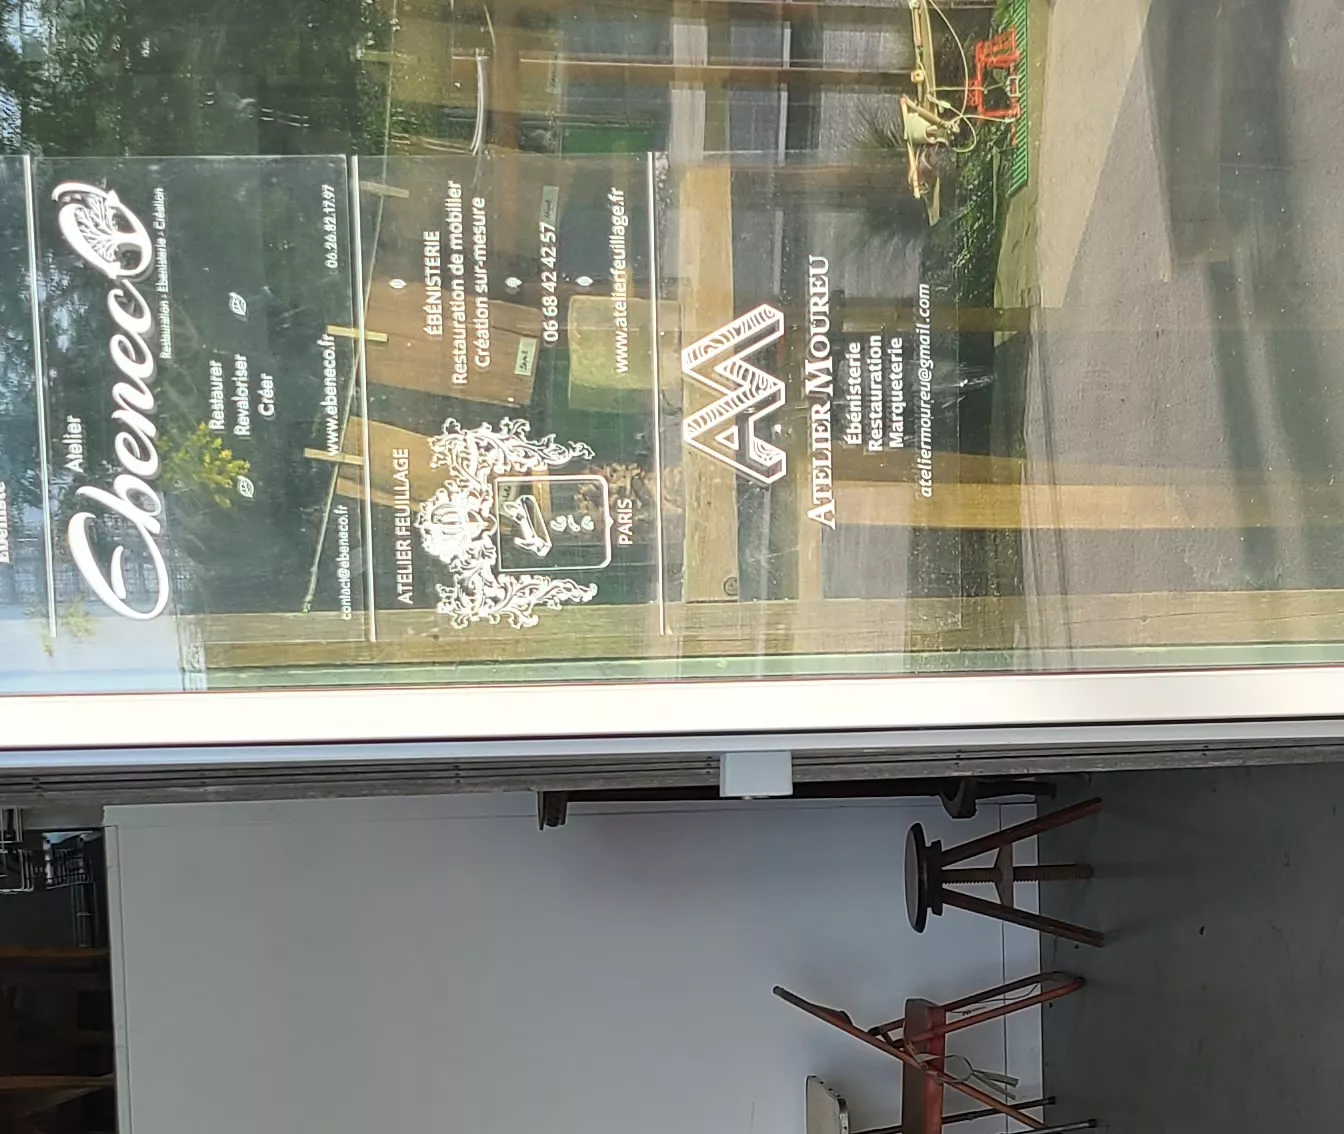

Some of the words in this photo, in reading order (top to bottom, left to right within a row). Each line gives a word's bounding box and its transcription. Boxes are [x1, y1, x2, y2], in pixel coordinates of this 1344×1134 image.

[445, 180, 463, 250] mobilier
[471, 197, 489, 293] sur-mesure
[539, 221, 556, 243] 57
[422, 230, 443, 335] ÉBÉNISTERIE
[447, 253, 464, 275] de
[540, 246, 557, 268] 42
[541, 271, 557, 293] 42
[607, 187, 631, 373] www.atelierfeuillage.fr
[159, 300, 172, 360] Restauration
[449, 279, 468, 384] Restauration
[471, 297, 491, 367] Création
[541, 296, 558, 317] 68
[542, 320, 559, 342] 06
[804, 254, 834, 397] MOUREU
[207, 359, 226, 430] Restaurer
[231, 354, 252, 436] Revaloriser
[256, 373, 276, 416] Créer
[317, 334, 339, 456] www.ebeneco.fr
[843, 342, 863, 445] Ébénisterie
[866, 335, 884, 452] Restauration
[887, 337, 907, 448] Marqueterie
[915, 283, 935, 497] ateliermoureu@gmail.com
[62, 415, 85, 473] Atelier
[806, 401, 836, 530] ATELIER
[392, 447, 412, 536] FEUILLAGE
[617, 498, 635, 545] PARIS
[333, 504, 353, 620] contact@ebeneco.fr
[395, 539, 414, 605] ATELIER
